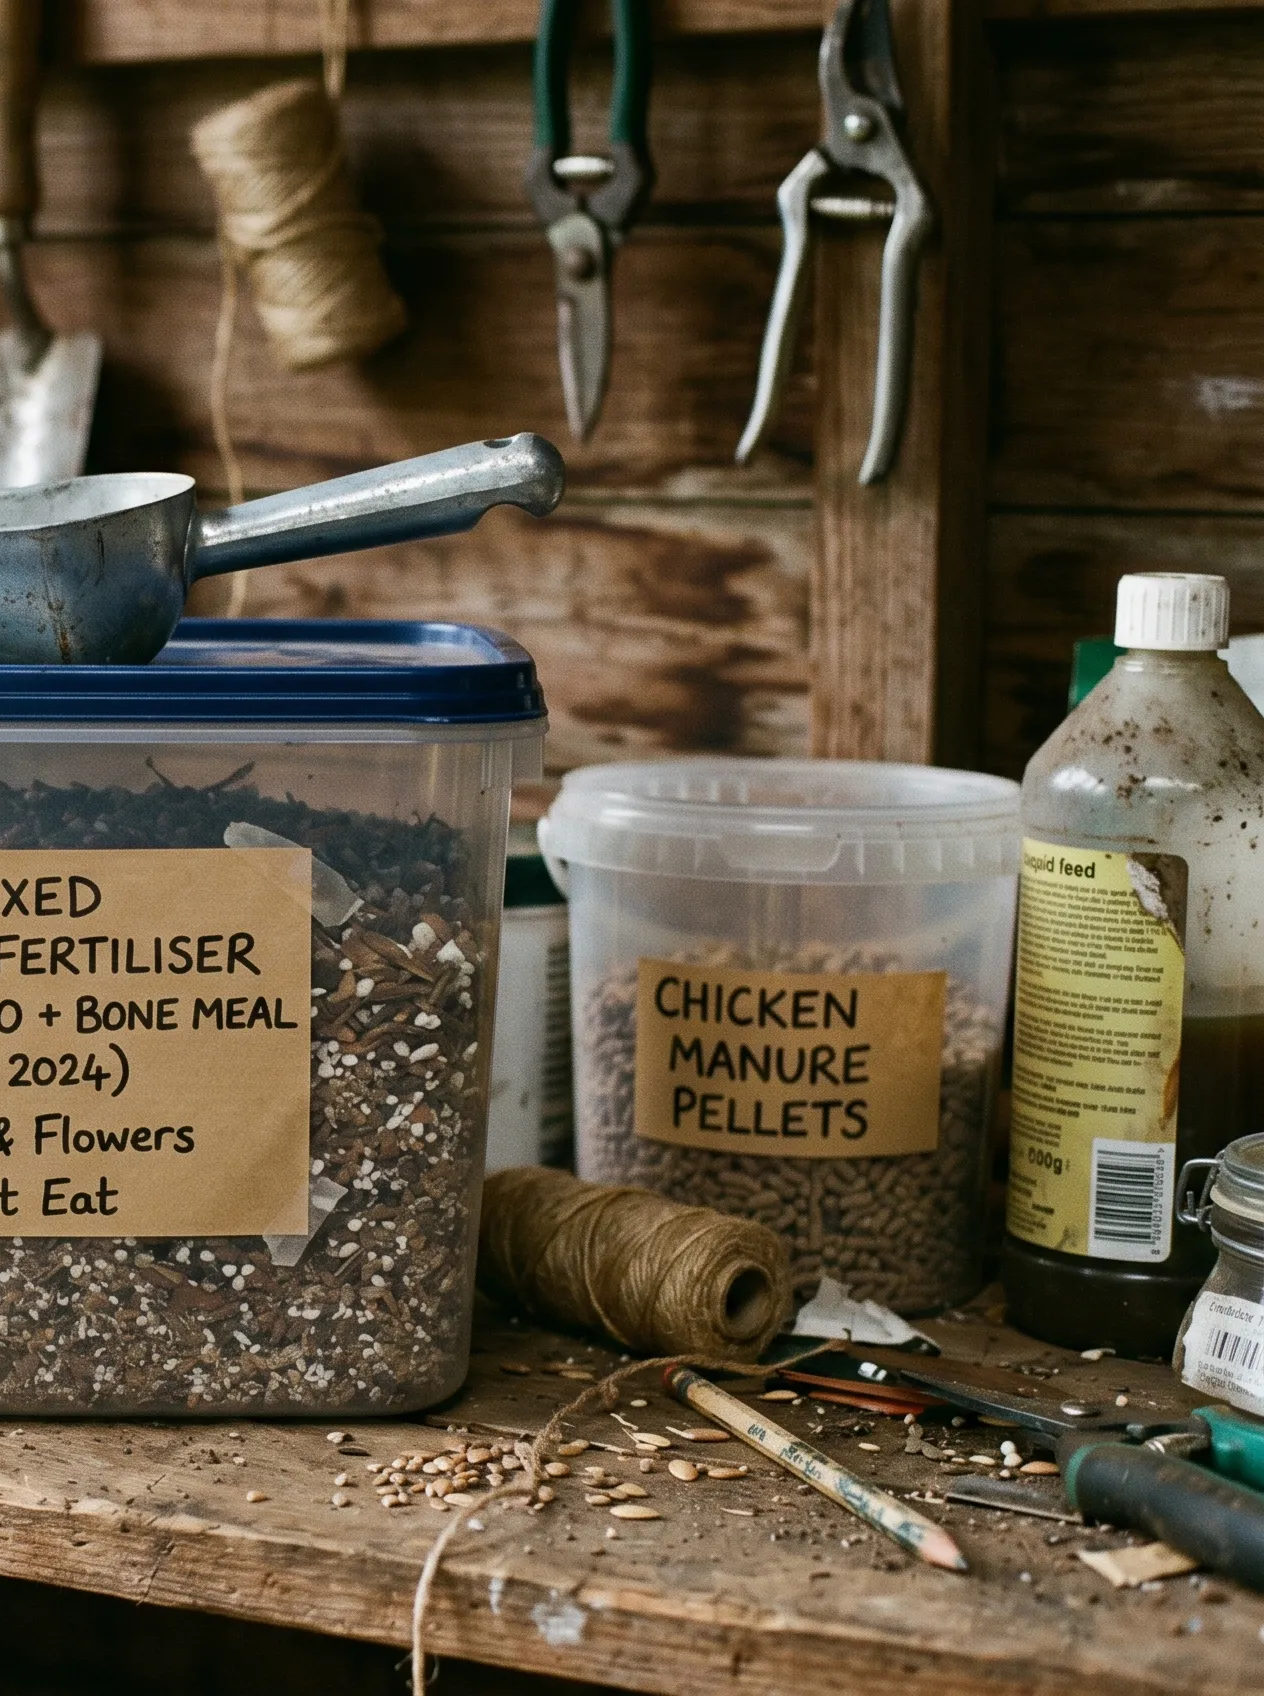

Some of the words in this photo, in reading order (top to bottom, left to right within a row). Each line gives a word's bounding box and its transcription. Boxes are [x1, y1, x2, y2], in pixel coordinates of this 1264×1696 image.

[1059, 857, 1095, 879] feed
[38, 1004, 61, 1028] +
[76, 995, 179, 1034] BONE
[192, 996, 299, 1034] MEAL
[654, 976, 858, 1029] CHICKEN
[7, 1042, 130, 1098] 2024)
[669, 1034, 870, 1086] MANURE
[34, 1112, 195, 1155] Flowers
[672, 1086, 869, 1140] PELLETS
[41, 1175, 119, 1217] Eat
